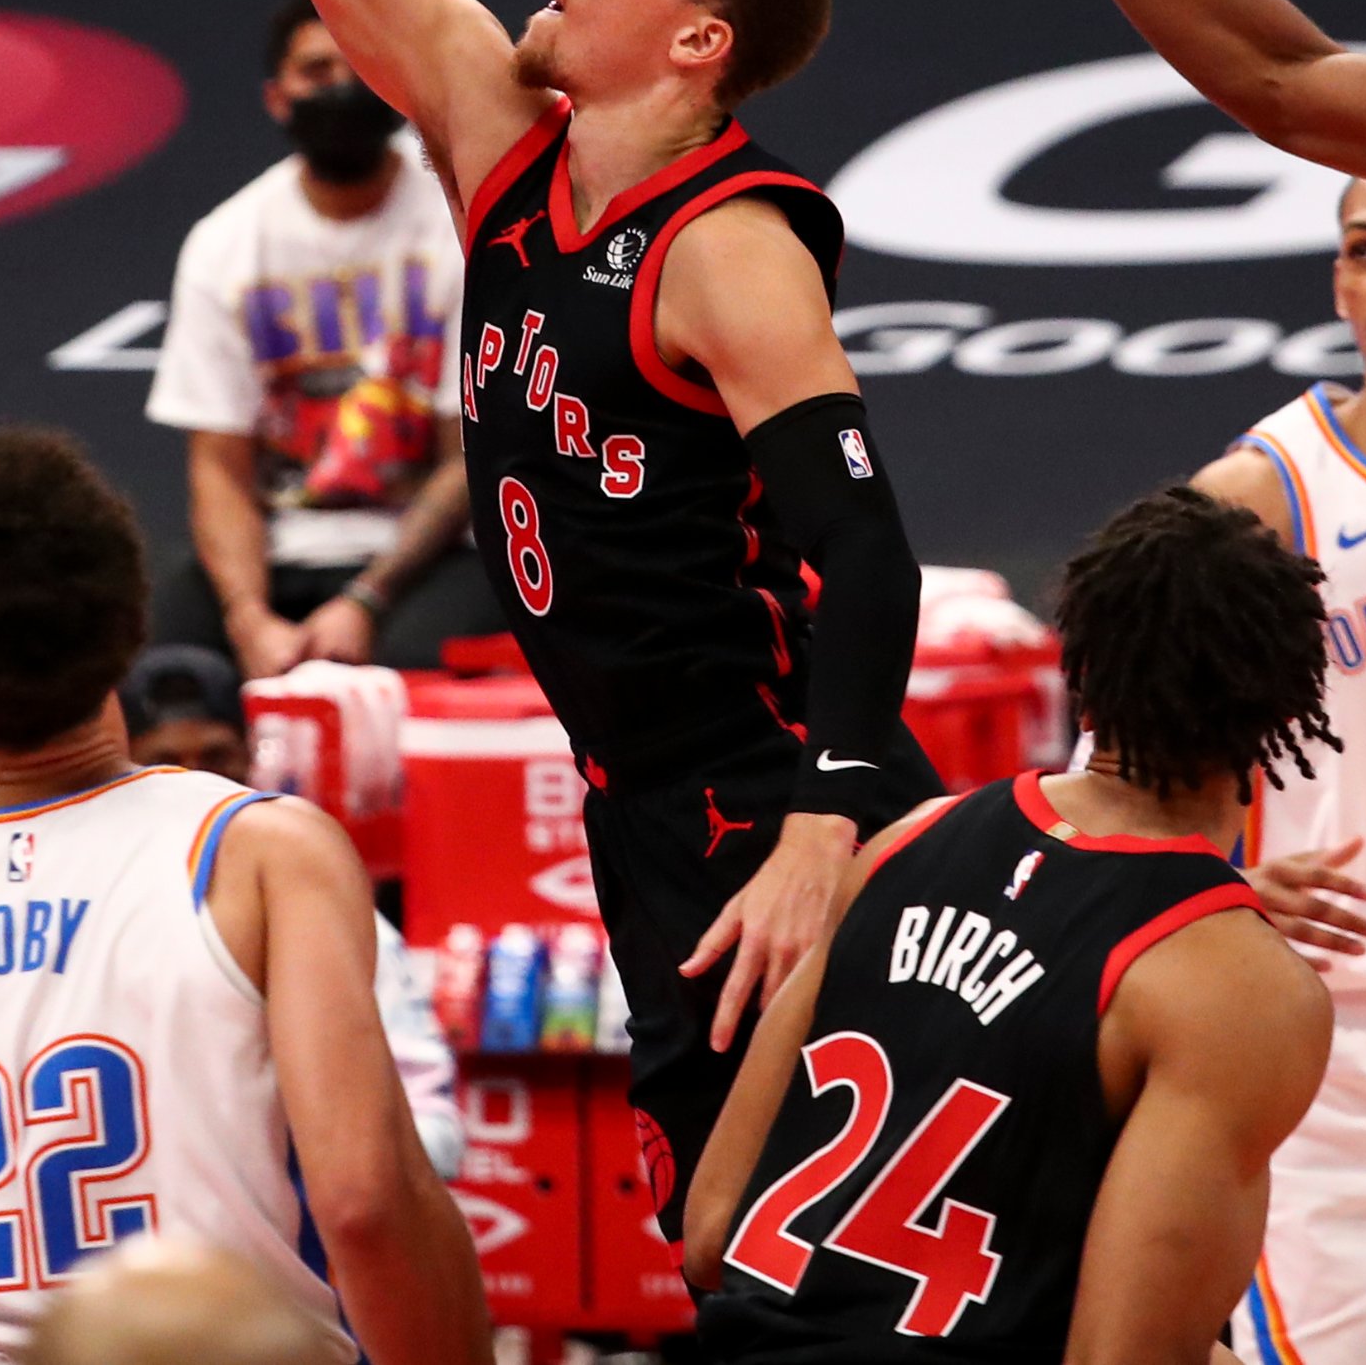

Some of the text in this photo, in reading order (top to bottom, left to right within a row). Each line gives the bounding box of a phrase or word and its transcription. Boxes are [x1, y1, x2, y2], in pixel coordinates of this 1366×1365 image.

[583, 265, 611, 285] Sun
[463, 309, 645, 498] APTORS
[499, 476, 553, 617] 8
[889, 905, 1044, 1026] BIRCH
[722, 1031, 1012, 1337] 24
